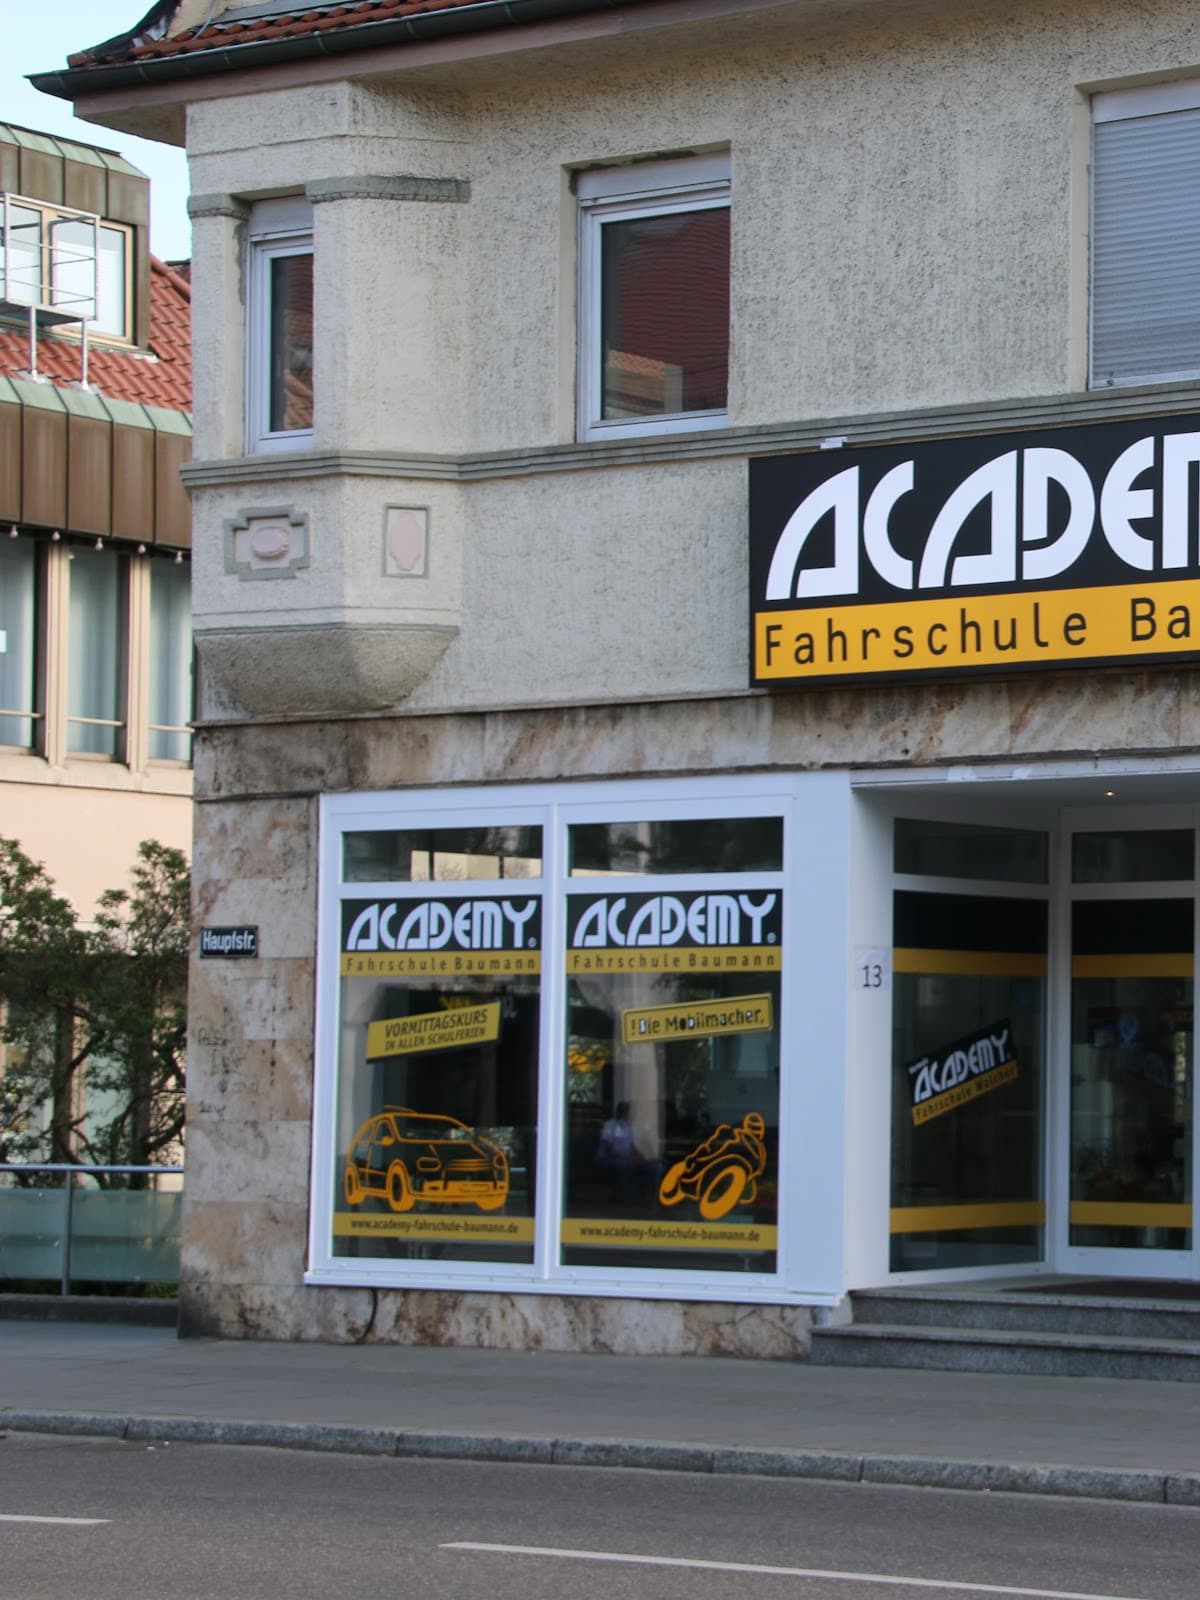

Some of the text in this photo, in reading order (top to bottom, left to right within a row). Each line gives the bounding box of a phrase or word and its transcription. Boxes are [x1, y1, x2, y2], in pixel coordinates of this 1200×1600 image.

[765, 602, 1087, 667] Fahrschule
[346, 899, 537, 951] ACADEMY
[573, 893, 776, 947] ACADEMY
[202, 929, 257, 954] Hauptstr.
[346, 956, 536, 972] Fahrschule Baumann
[573, 953, 775, 969] Fahrschule Baumann
[861, 964, 882, 988] 13
[384, 1008, 488, 1038] VORMITTAGSKURS
[398, 1034, 425, 1049] ALLEN
[427, 1026, 487, 1045] SCHULFERIEN
[914, 1028, 1009, 1104] ACADEMY
[351, 1218, 519, 1234] www.academy-fahrschule-baumann.de
[579, 1225, 761, 1242] www.academy-fahrschule-baumann.de
